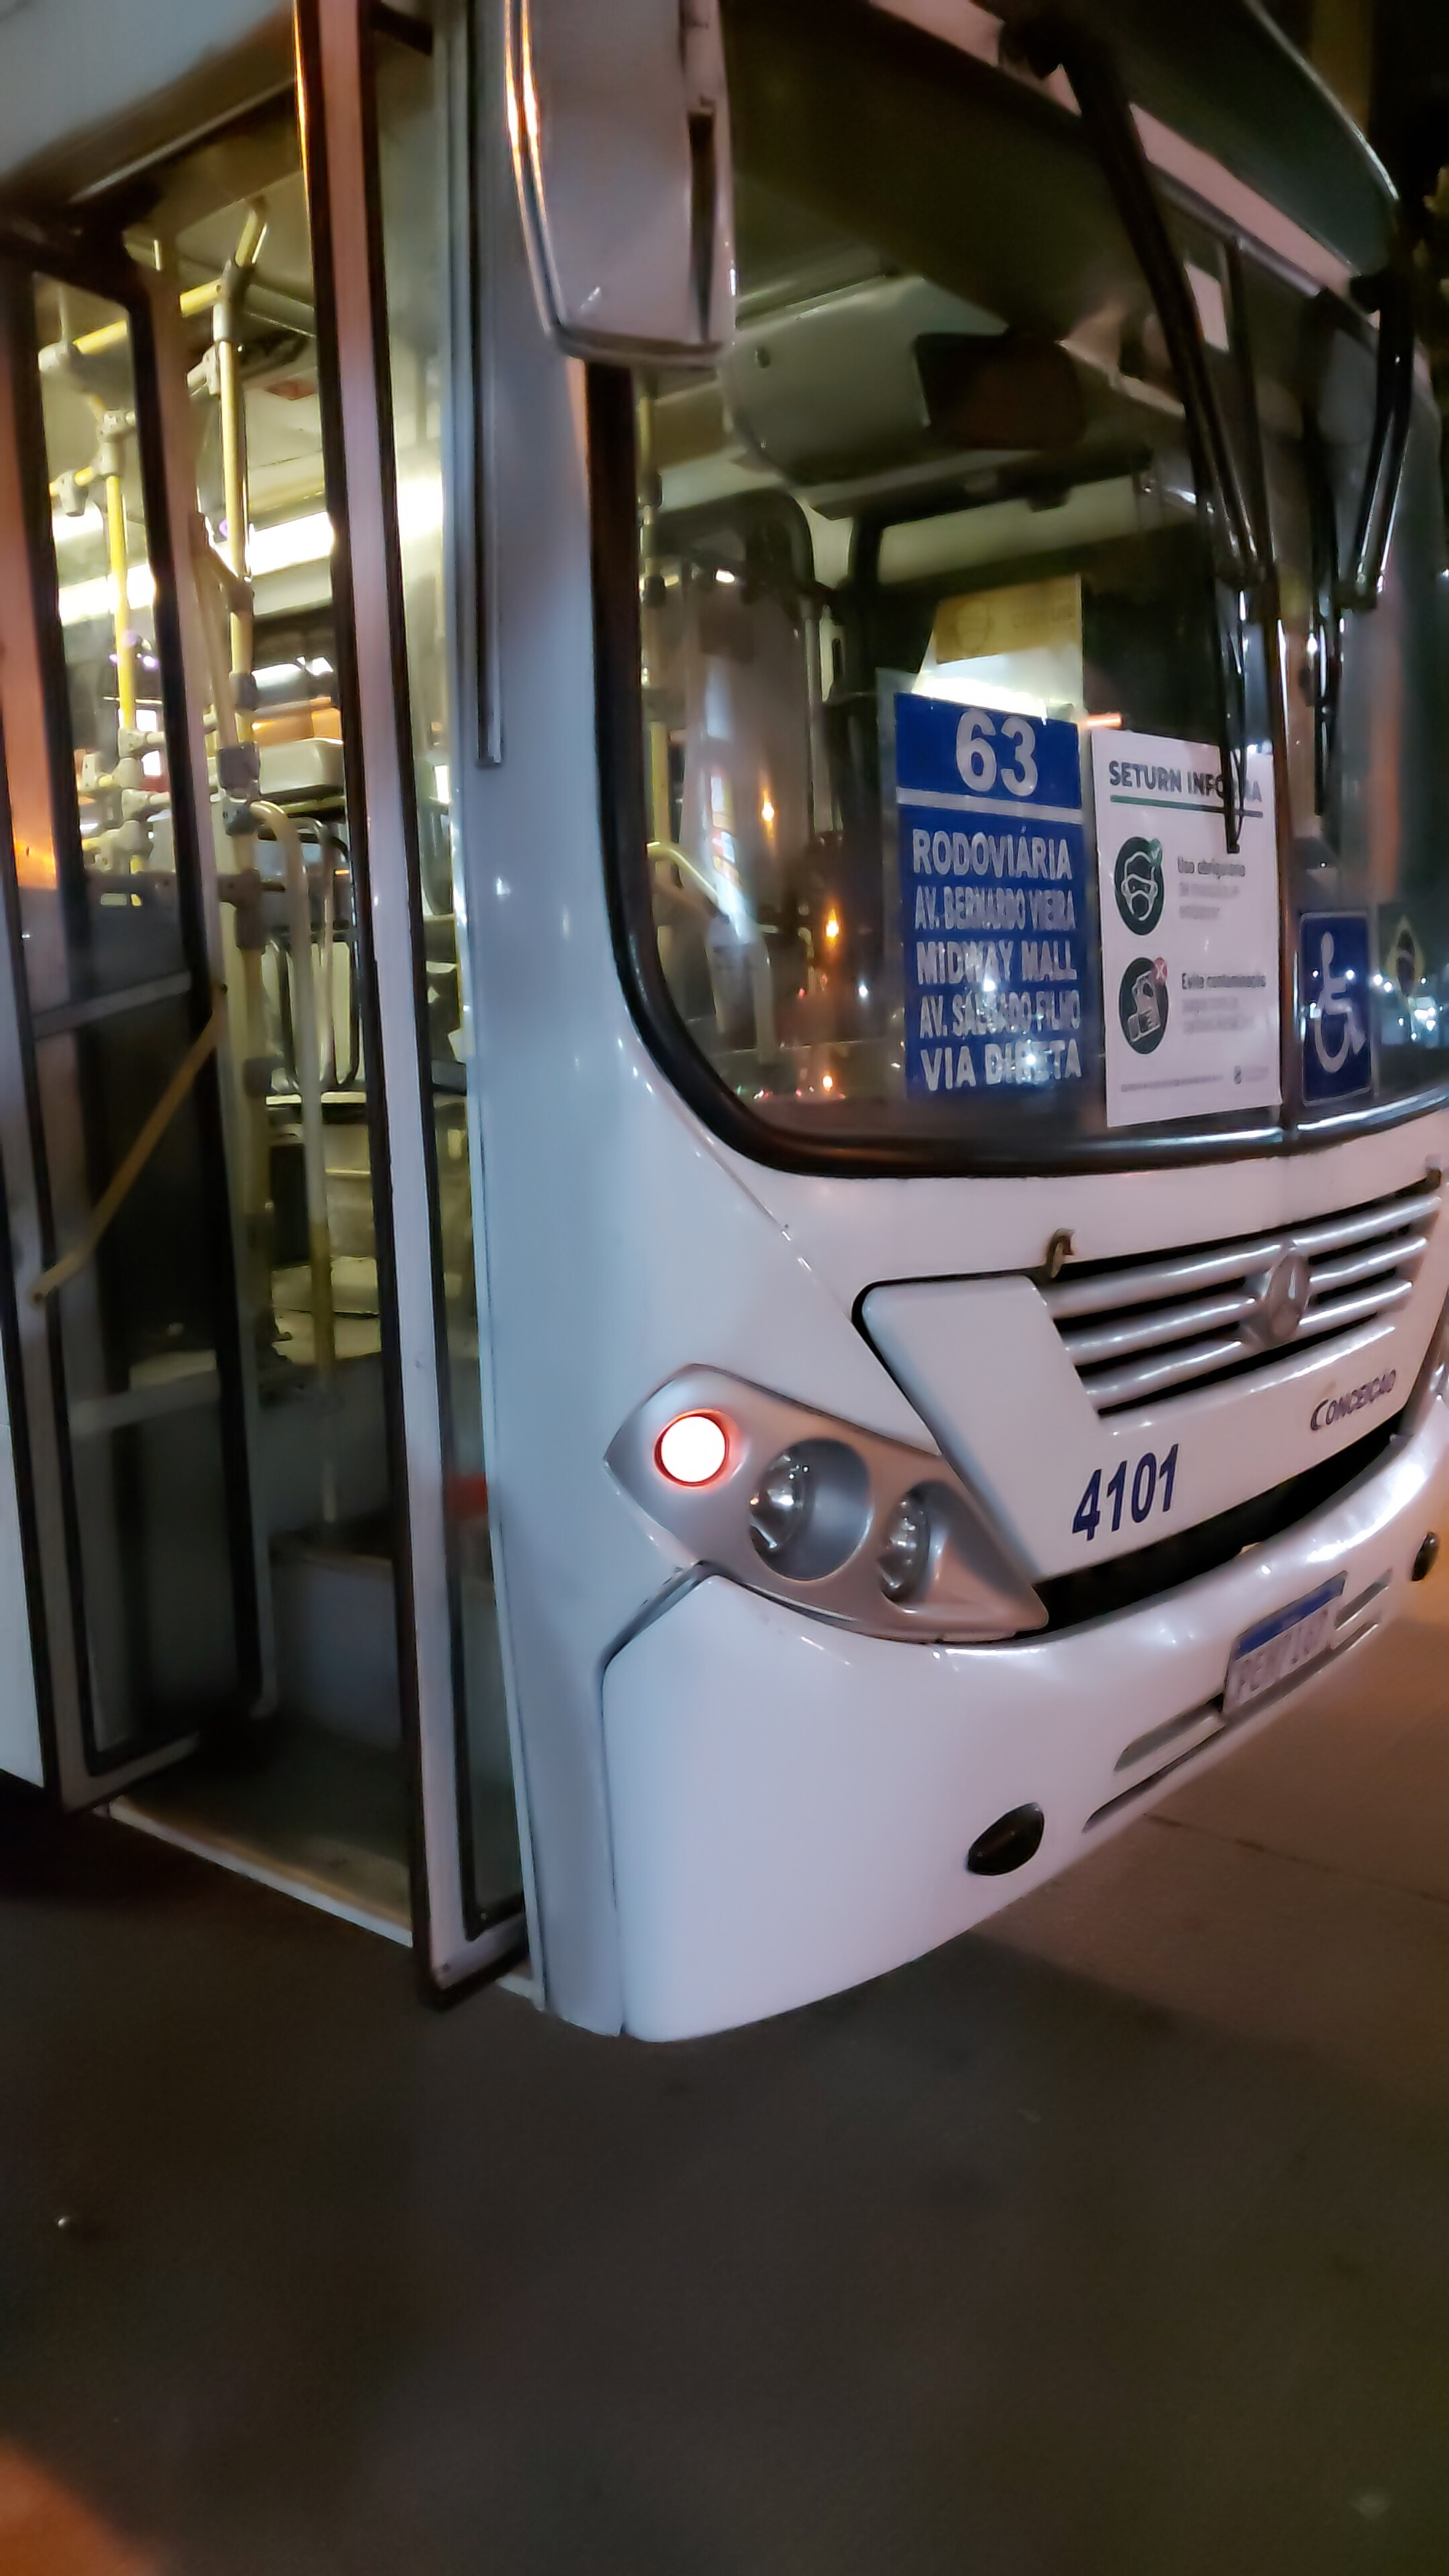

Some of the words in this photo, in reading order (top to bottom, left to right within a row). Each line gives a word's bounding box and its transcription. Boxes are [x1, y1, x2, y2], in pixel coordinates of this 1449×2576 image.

[956, 709, 1038, 796] 63
[1109, 760, 1182, 793] SETURN
[912, 826, 1073, 880] RODOVIÁRIA
[915, 885, 940, 930] AV.
[916, 940, 1014, 985] MIDWAY
[1021, 940, 1077, 982] MALL
[920, 995, 948, 1039] AV.
[920, 1045, 977, 1091] VIA
[984, 1038, 1082, 1085] DIRETA
[1072, 1443, 1179, 1542] 4101
